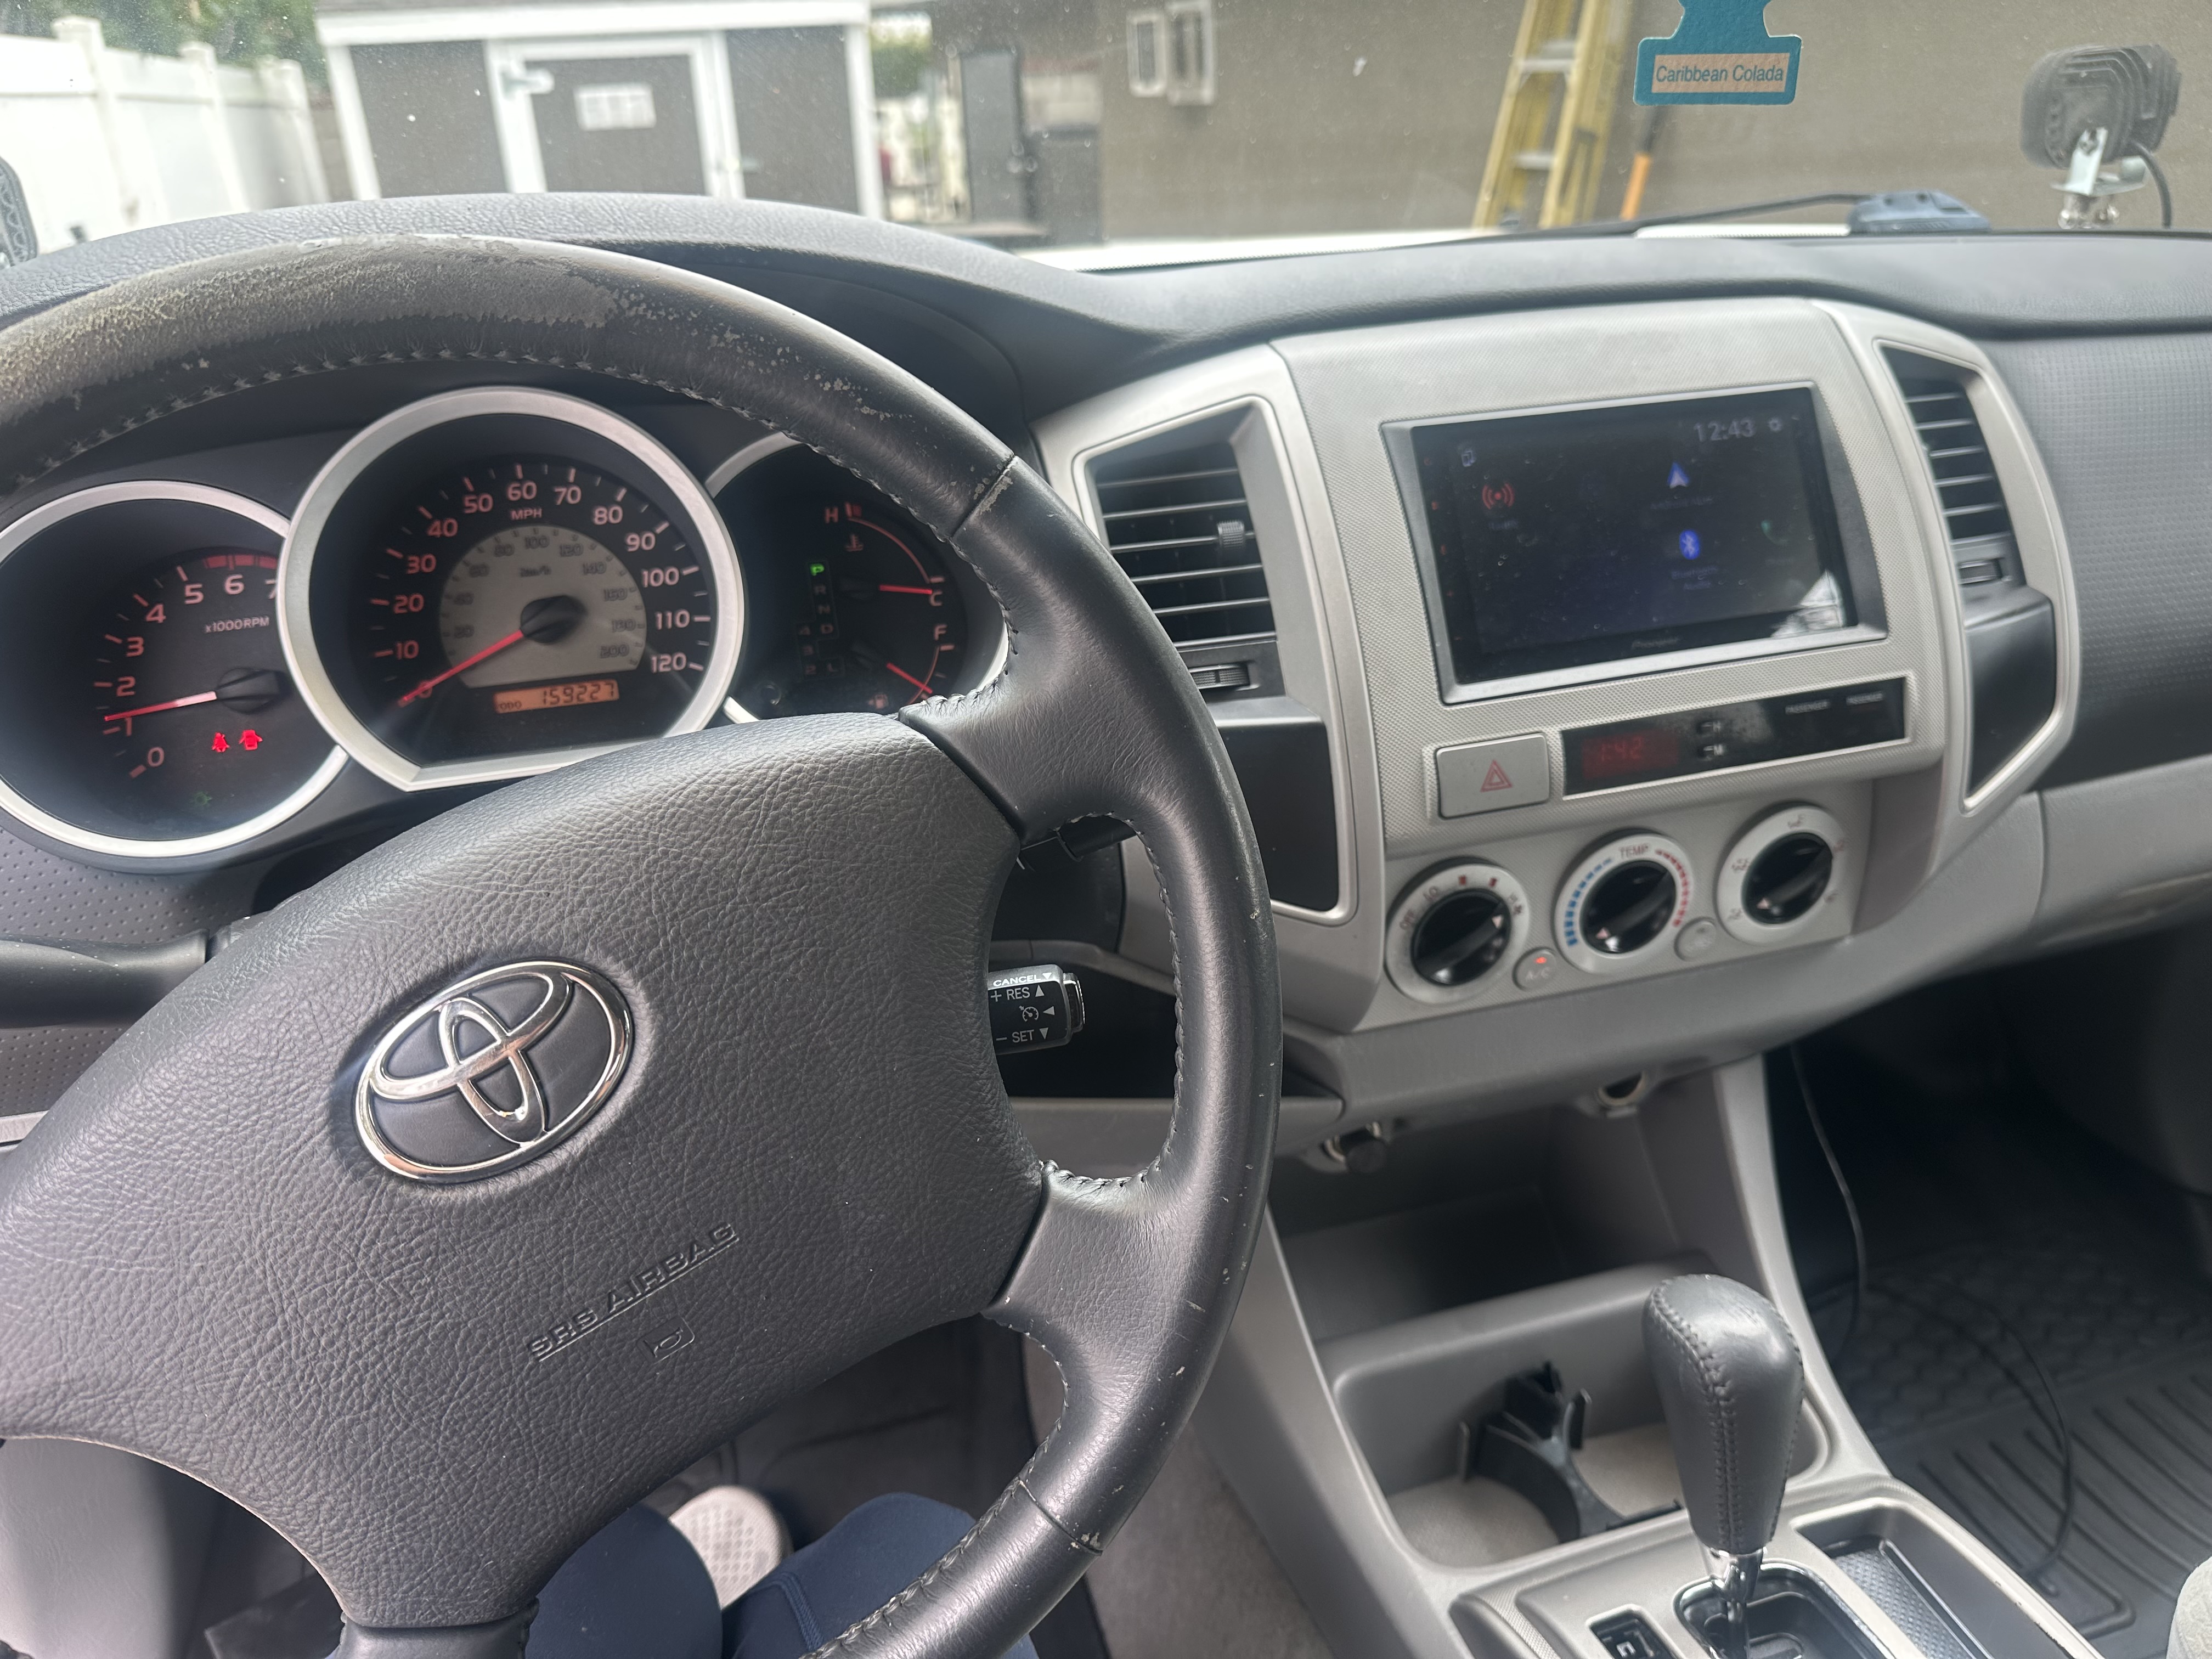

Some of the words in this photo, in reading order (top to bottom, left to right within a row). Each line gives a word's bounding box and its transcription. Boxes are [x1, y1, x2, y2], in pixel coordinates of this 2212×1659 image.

[1656, 65, 1728, 82] Caribbean
[1732, 64, 1784, 82] Colada
[1693, 417, 1755, 443] 12:43
[506, 481, 537, 500] 60
[554, 486, 582, 505] 70
[464, 493, 493, 514] 50
[511, 507, 543, 521] MPH
[592, 505, 623, 525] 80
[824, 507, 839, 524] H
[427, 518, 458, 538] 40
[625, 532, 656, 552] 90
[407, 554, 437, 574] 30
[224, 574, 244, 595] 6
[642, 567, 680, 588] 100
[184, 584, 205, 605] 5
[393, 594, 424, 613] 20
[145, 603, 166, 624] 4
[655, 610, 690, 629] 110
[934, 624, 947, 641] F
[126, 637, 145, 657] 3
[396, 640, 419, 659] 10
[651, 653, 687, 673] 120
[116, 676, 136, 697] 2
[542, 682, 615, 706] 159227
[123, 718, 132, 736] 1
[146, 747, 165, 767] 0
[992, 974, 1041, 987] CANCEL
[1006, 986, 1030, 1000] RES
[1012, 1029, 1035, 1043] SET
[528, 1308, 599, 1358] SRS
[607, 1221, 736, 1313] AIRBAG
